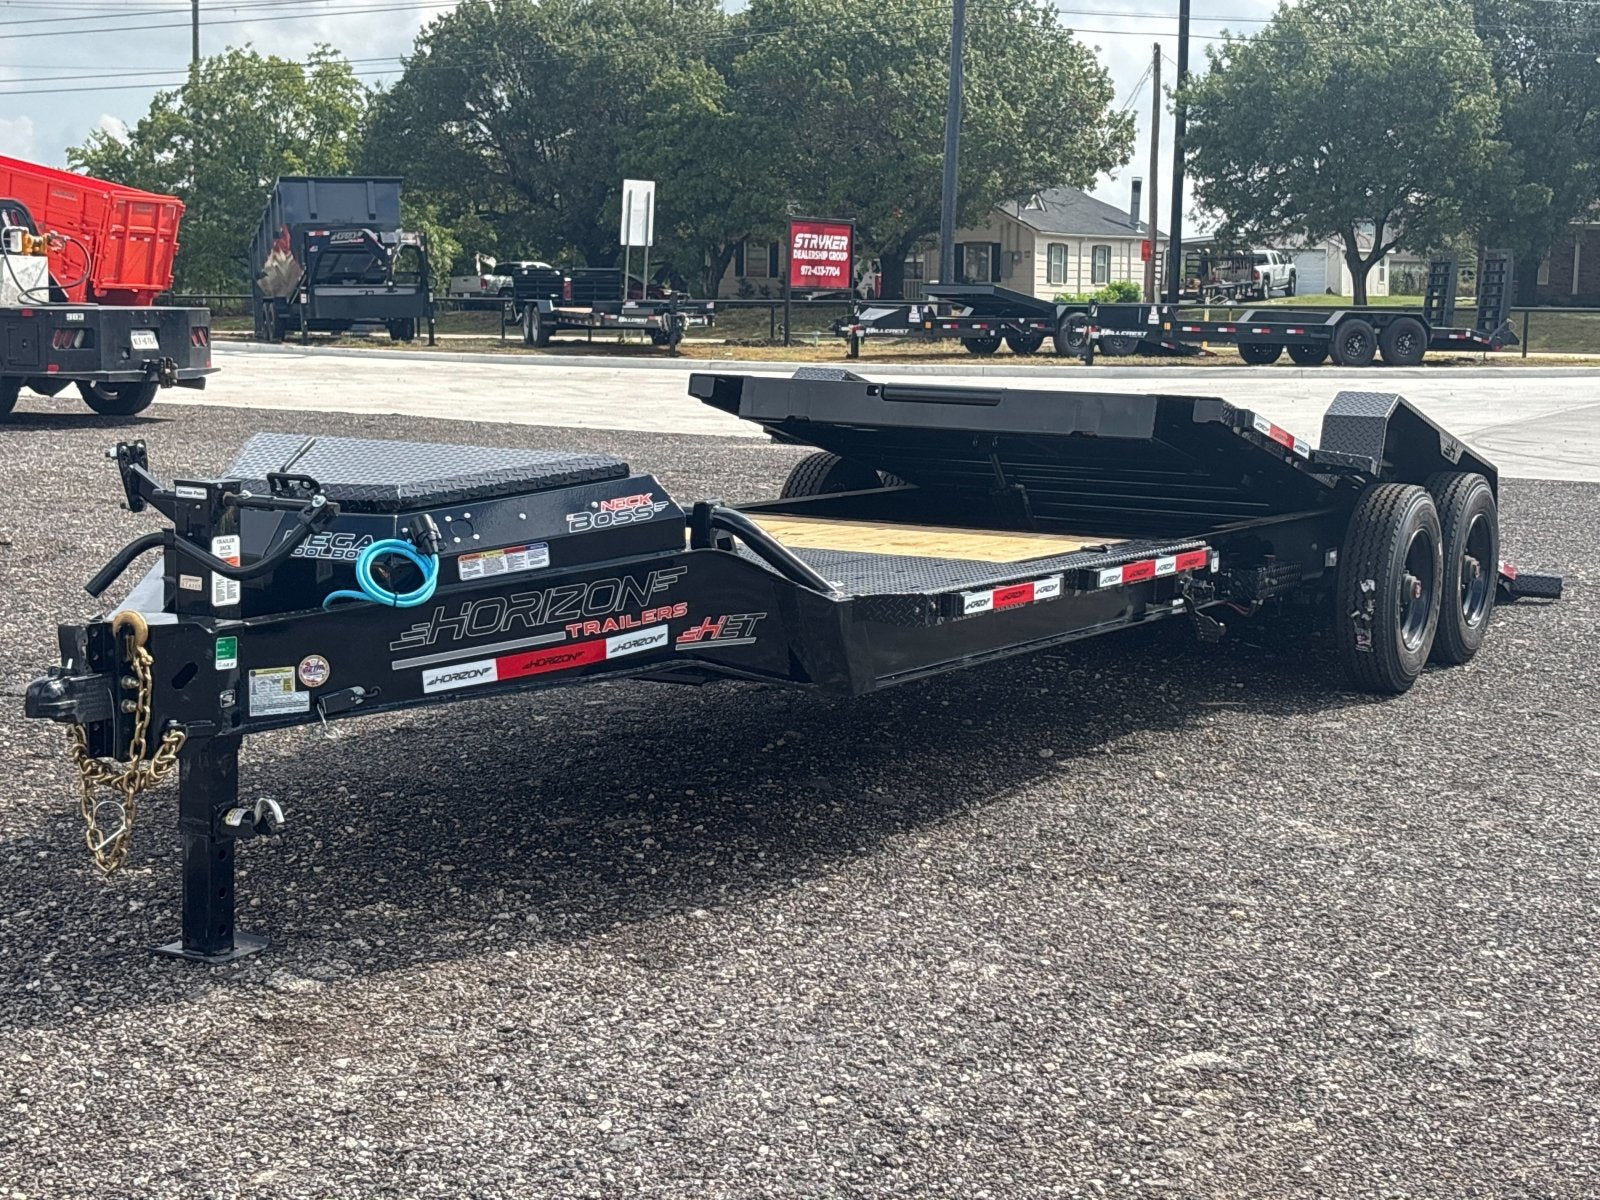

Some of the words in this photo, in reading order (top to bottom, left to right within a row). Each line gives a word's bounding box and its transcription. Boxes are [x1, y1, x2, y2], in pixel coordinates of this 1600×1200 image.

[794, 233, 848, 250] STRYKER
[793, 249, 828, 260] DEALERSHIP
[829, 251, 848, 261] GROUP
[800, 265, 840, 276] 972-433-7704
[601, 493, 653, 511] NECK
[566, 505, 655, 533] BOSS
[415, 569, 668, 646] HORIZON
[566, 603, 688, 638] TRAILERS
[692, 612, 767, 640] HET
[614, 634, 662, 652] HORIZON
[526, 652, 581, 669] HORIZON
[430, 667, 488, 685] HORIZON
